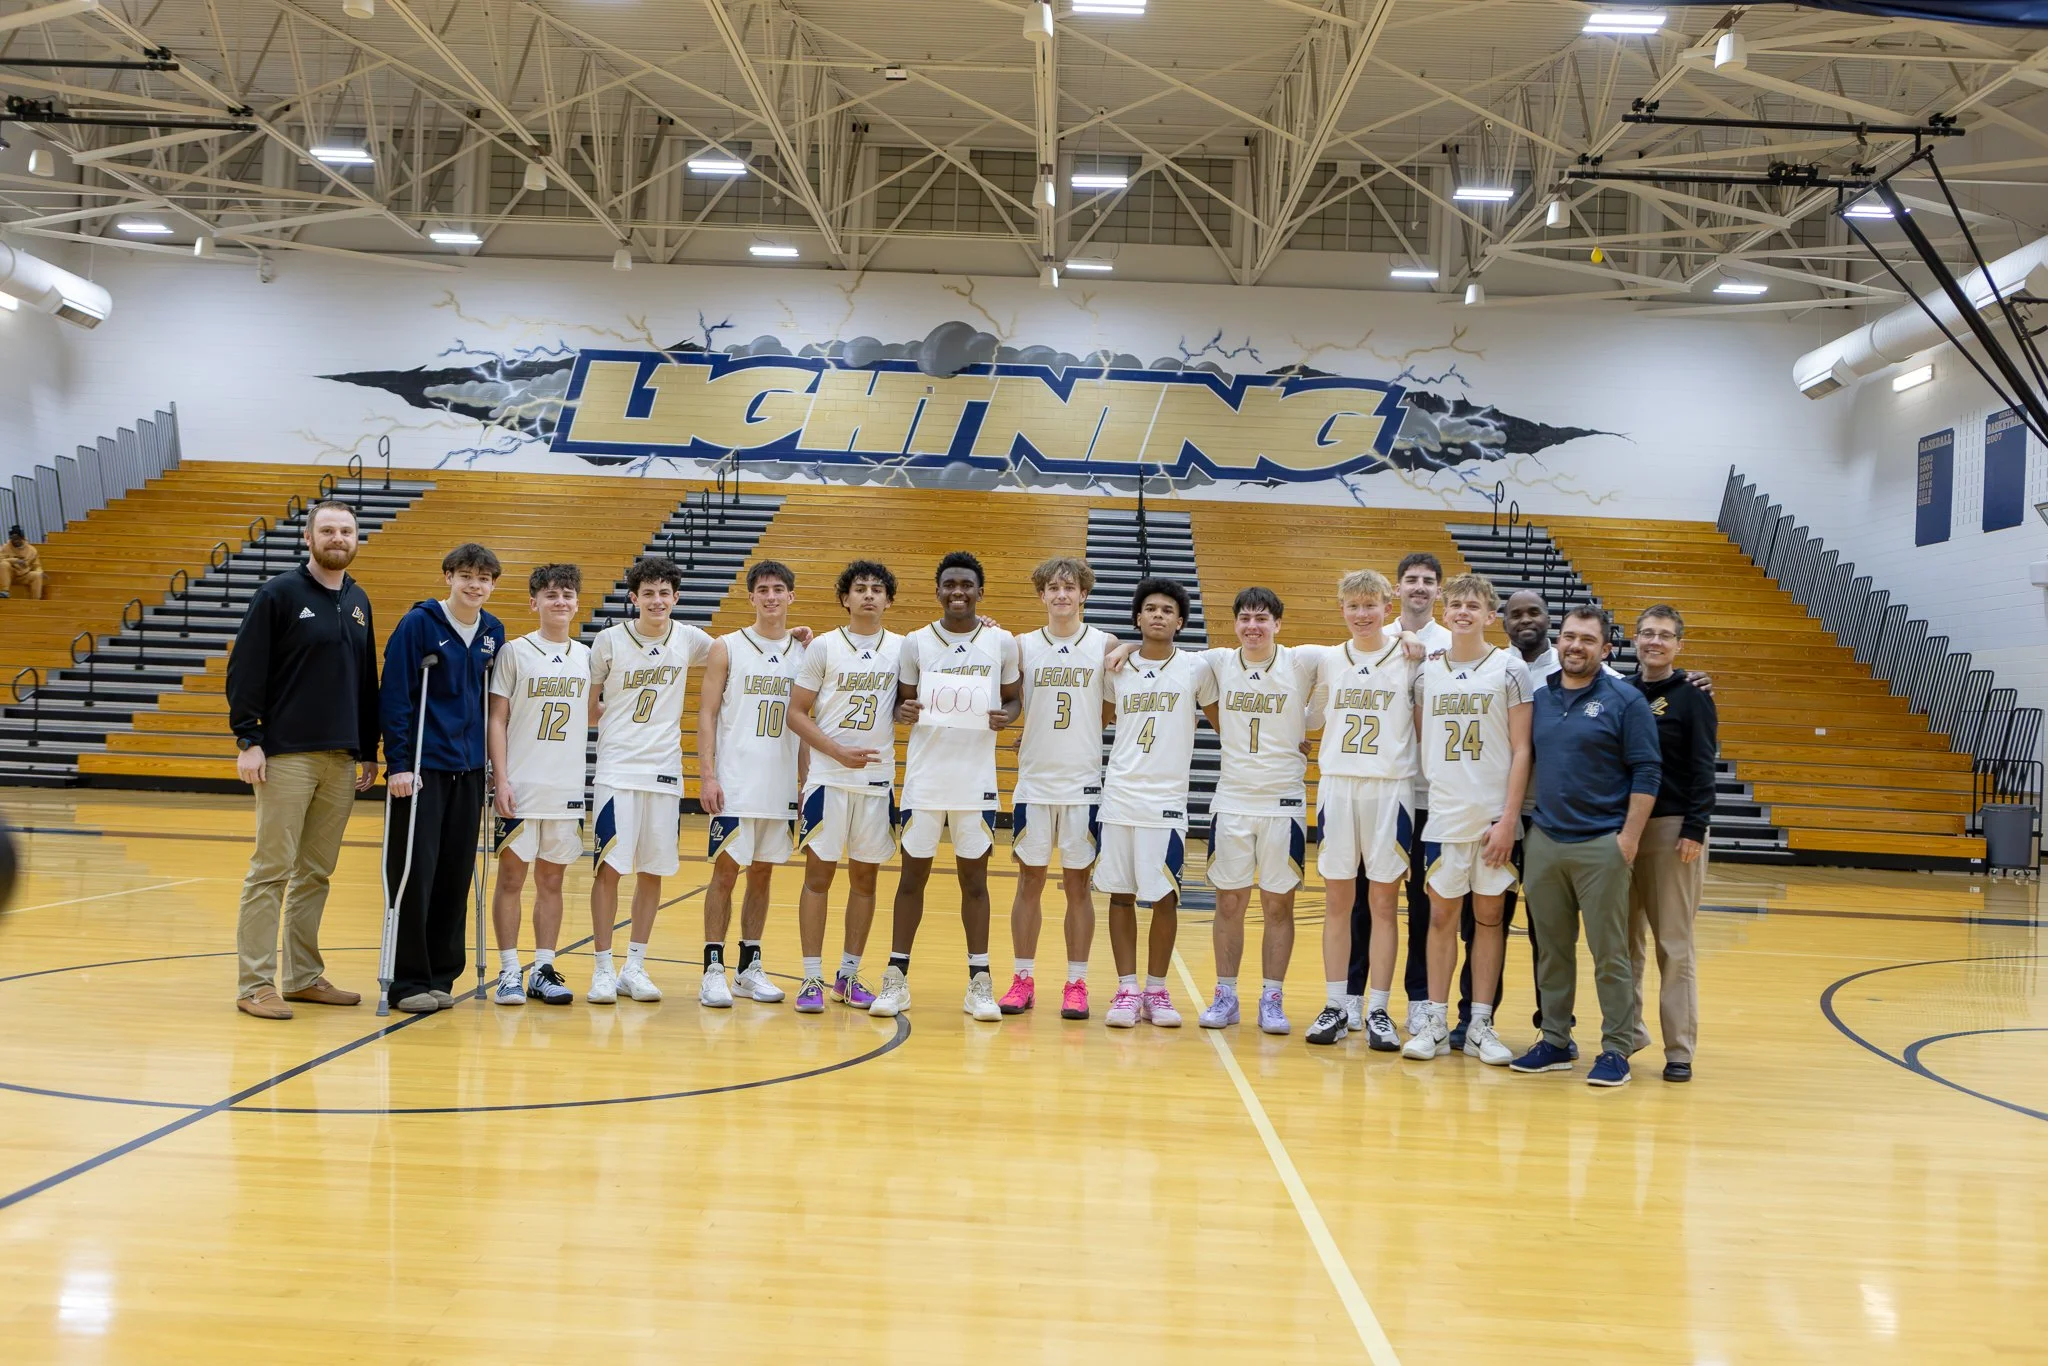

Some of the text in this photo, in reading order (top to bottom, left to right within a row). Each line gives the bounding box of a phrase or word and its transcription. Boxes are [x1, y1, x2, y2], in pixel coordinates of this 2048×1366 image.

[555, 352, 1402, 478] LIGHTNING
[1987, 413, 2025, 435] BASKETBAL
[1986, 432, 2002, 444] 2007
[528, 677, 586, 698] LEGACY
[623, 666, 682, 690] LEGACY
[836, 671, 895, 692] LEGACY
[1034, 667, 1094, 688] LEGACY
[632, 688, 657, 723] 0
[839, 694, 878, 731] 23
[930, 685, 989, 717] 1000
[1053, 692, 1071, 729] 3
[1123, 691, 1180, 714] LEGACY
[1225, 691, 1288, 713] LEGACY
[1334, 688, 1396, 711] LEGACY
[1432, 693, 1494, 716] LEGACY
[537, 702, 571, 741] 12
[756, 700, 785, 738] 10
[1137, 717, 1156, 753] 4
[1341, 714, 1380, 755] 22
[1249, 718, 1260, 754] 1
[1444, 720, 1483, 761] 24
